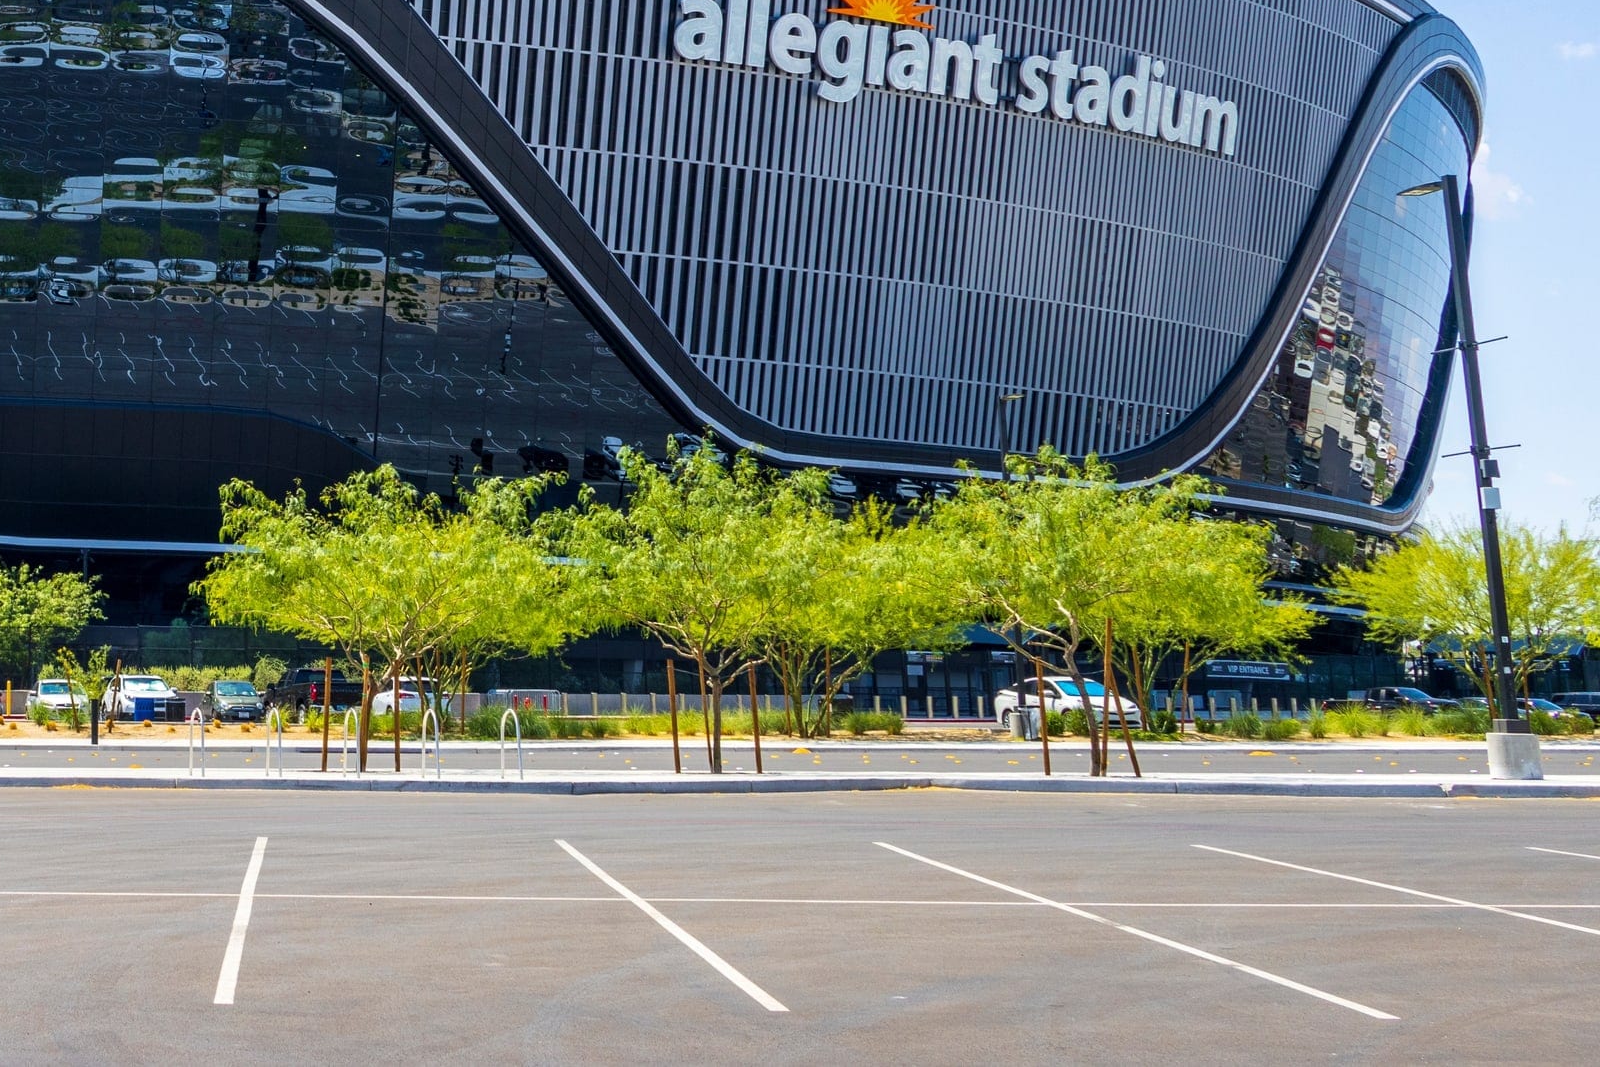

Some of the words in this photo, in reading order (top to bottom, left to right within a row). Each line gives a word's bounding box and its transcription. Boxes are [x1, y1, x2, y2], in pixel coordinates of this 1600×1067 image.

[1014, 48, 1240, 157] stadium
[1227, 665, 1238, 673] VIP
[1239, 665, 1270, 675] ENTRANCE
